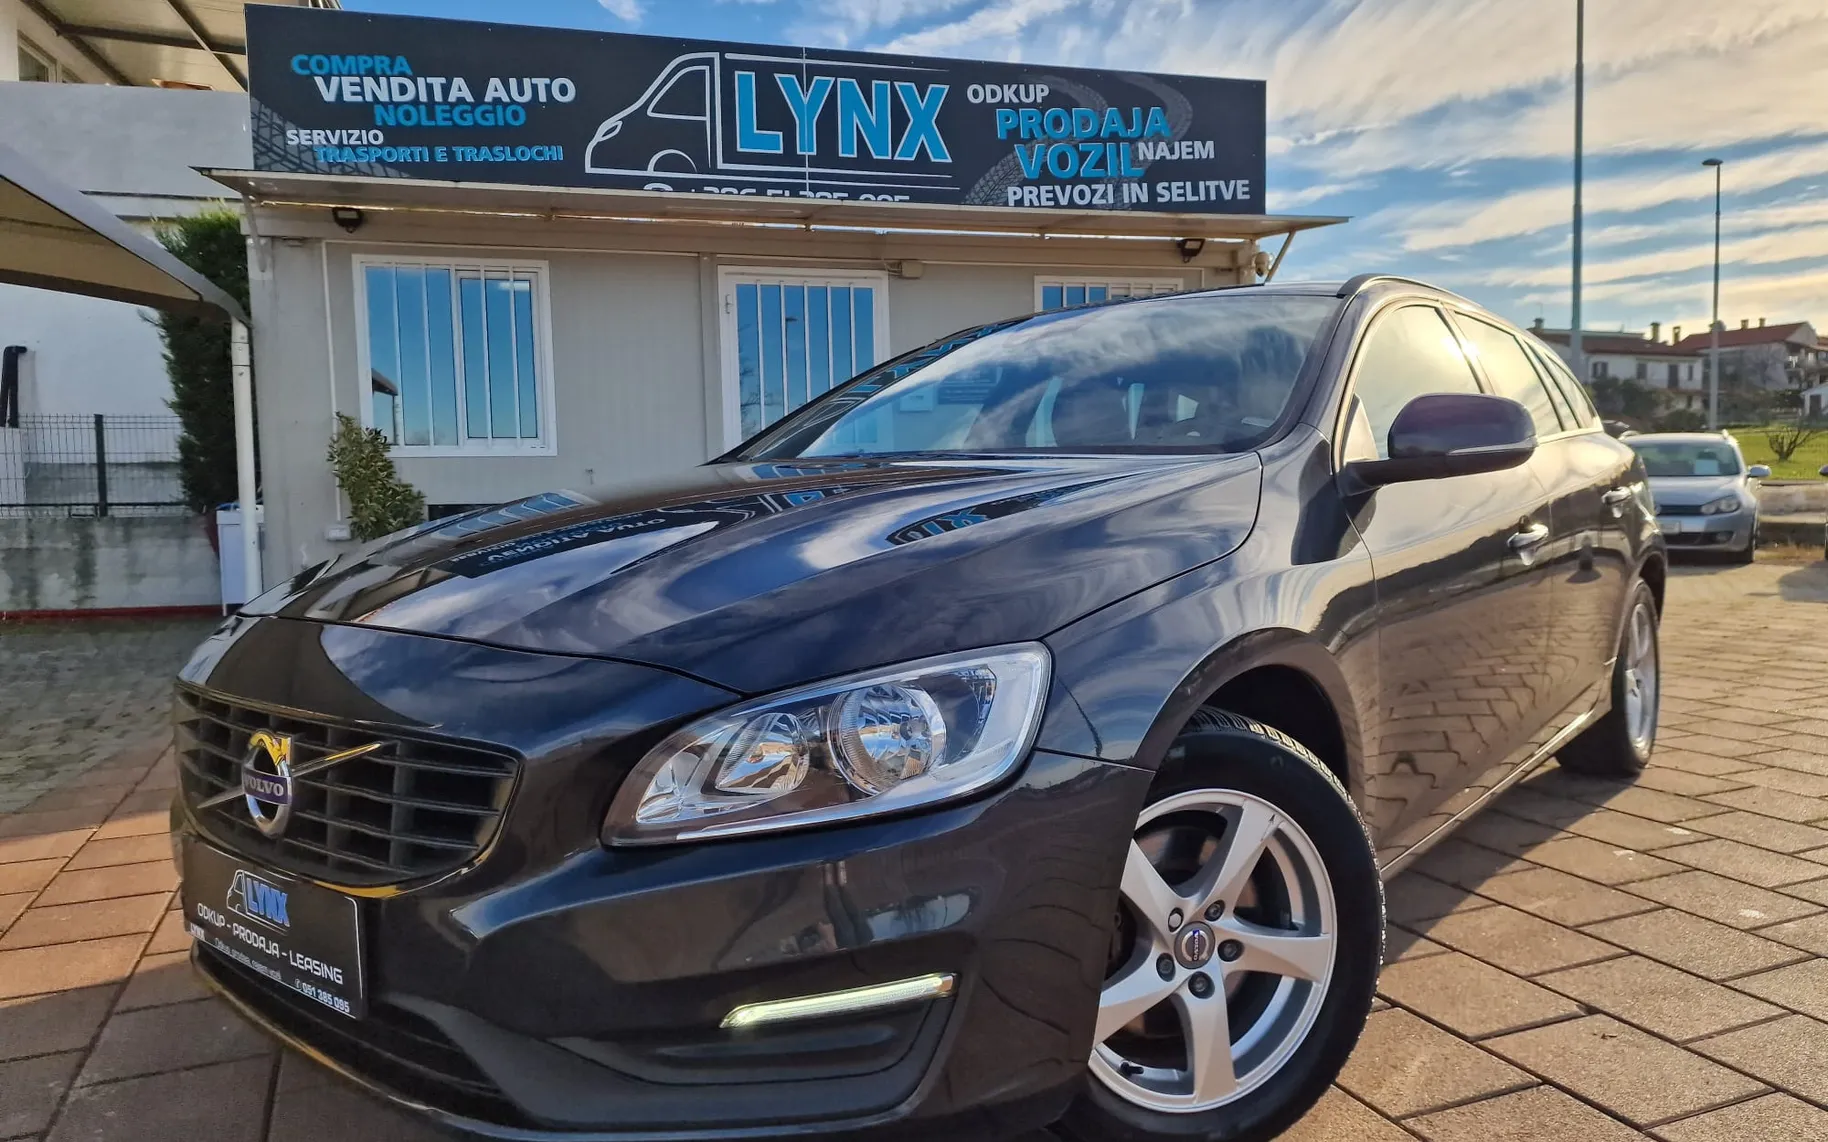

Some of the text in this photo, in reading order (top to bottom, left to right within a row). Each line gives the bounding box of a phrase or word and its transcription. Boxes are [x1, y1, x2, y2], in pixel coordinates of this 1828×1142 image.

[290, 54, 414, 77] COMPRA
[313, 76, 577, 103] VENDITA AUTO
[966, 83, 1050, 105] ODKUP
[373, 104, 527, 127] NOLEGGIO
[733, 69, 953, 164] LYNX
[995, 106, 1171, 140] PRODAJA
[286, 129, 385, 146] SERVIZIO
[313, 145, 564, 163] TRASPORTI E TRASLOCHI
[1014, 141, 1216, 180] VOZIL NAJEM
[1006, 180, 1251, 208] PREVOZI IN SELITVE
[243, 773, 284, 797] VOLVO
[246, 877, 290, 928] LYNX
[197, 902, 225, 928] ODKUP
[232, 922, 280, 959] PRODAJA
[289, 949, 343, 985] LEASING
